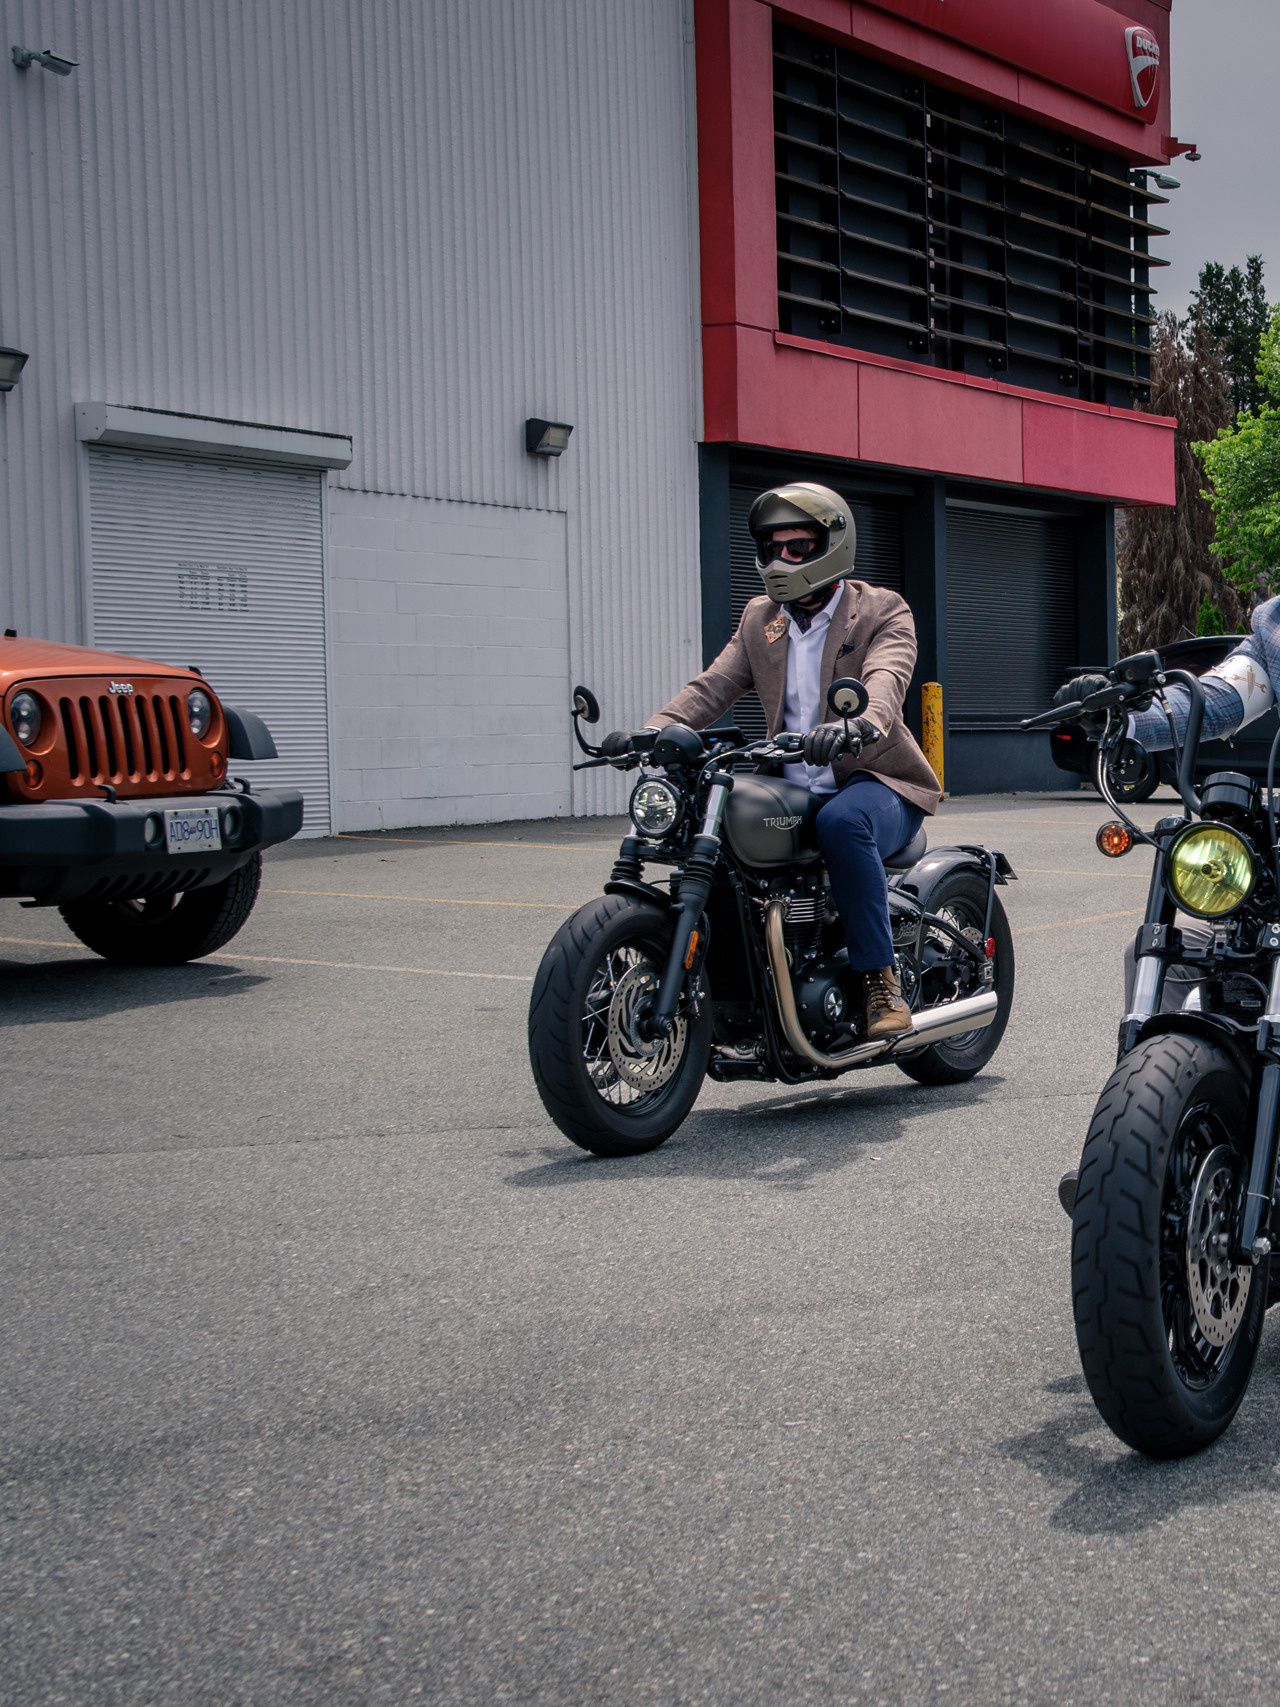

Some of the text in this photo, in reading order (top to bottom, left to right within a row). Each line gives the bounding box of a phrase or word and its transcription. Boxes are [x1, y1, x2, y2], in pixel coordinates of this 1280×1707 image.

[108, 681, 133, 696] Jeep
[763, 816, 802, 829] TRIUMPH
[170, 821, 190, 842] AD8
